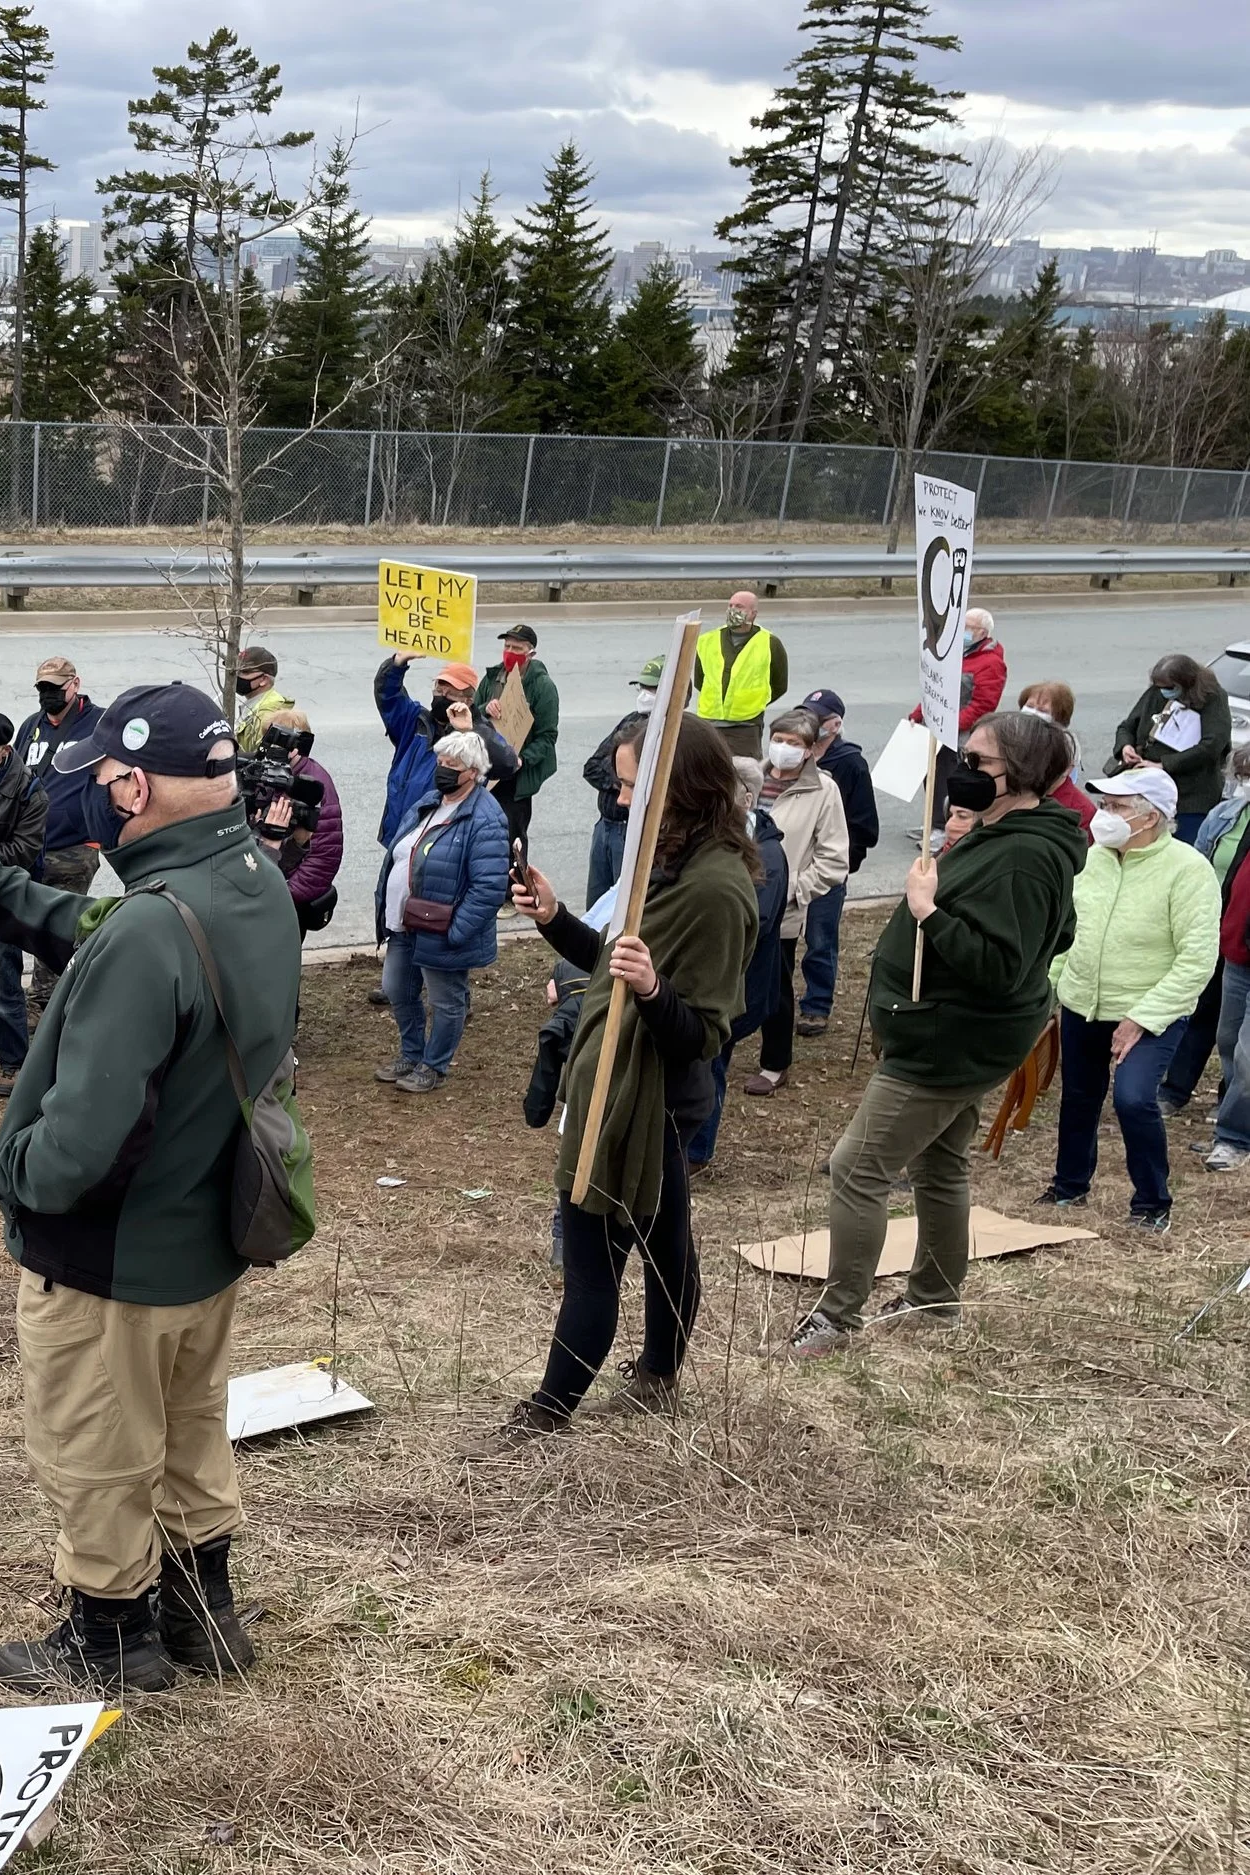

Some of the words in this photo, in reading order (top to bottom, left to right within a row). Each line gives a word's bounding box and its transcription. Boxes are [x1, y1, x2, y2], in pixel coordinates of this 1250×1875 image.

[923, 481, 958, 505] PROTECT
[385, 567, 425, 590] LET
[438, 577, 469, 598] MY
[385, 592, 449, 618] VOICE
[408, 613, 434, 631] BE
[385, 628, 451, 653] HEARD
